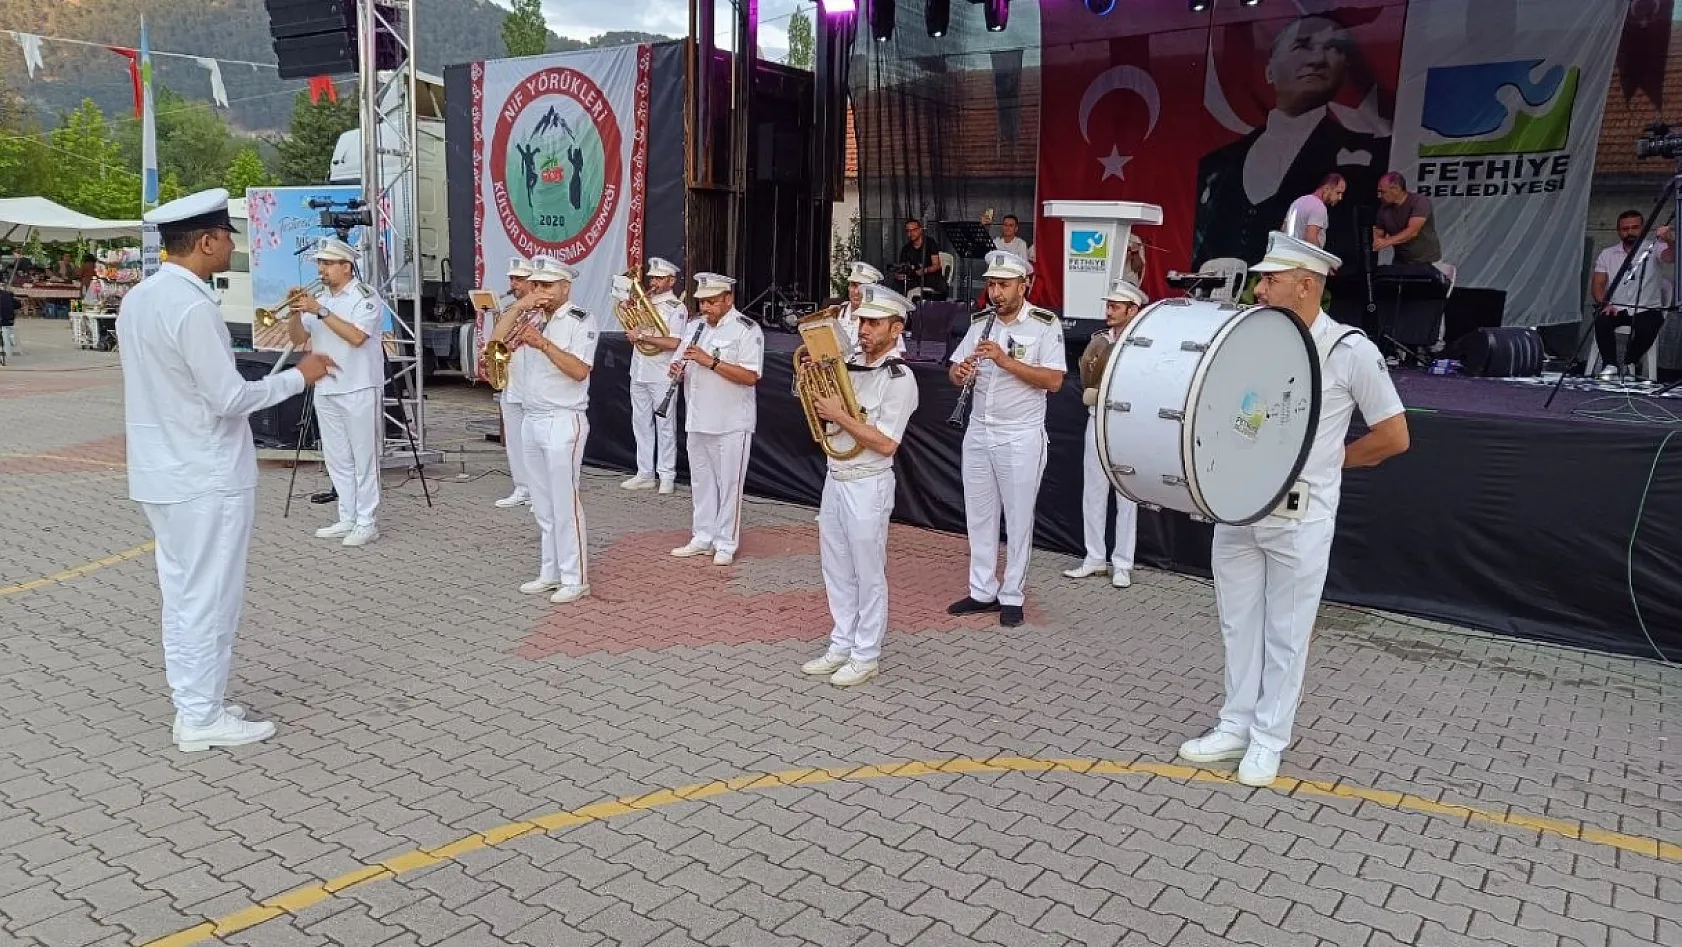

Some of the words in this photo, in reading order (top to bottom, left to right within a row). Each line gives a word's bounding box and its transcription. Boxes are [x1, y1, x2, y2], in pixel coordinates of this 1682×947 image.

[527, 70, 608, 121] YÖRÜKLERİ
[1418, 153, 1571, 181] FETHİYE
[1417, 175, 1565, 197] BELEDİYESİ
[495, 181, 520, 238] KÜLTÜR
[540, 215, 565, 226] 2020
